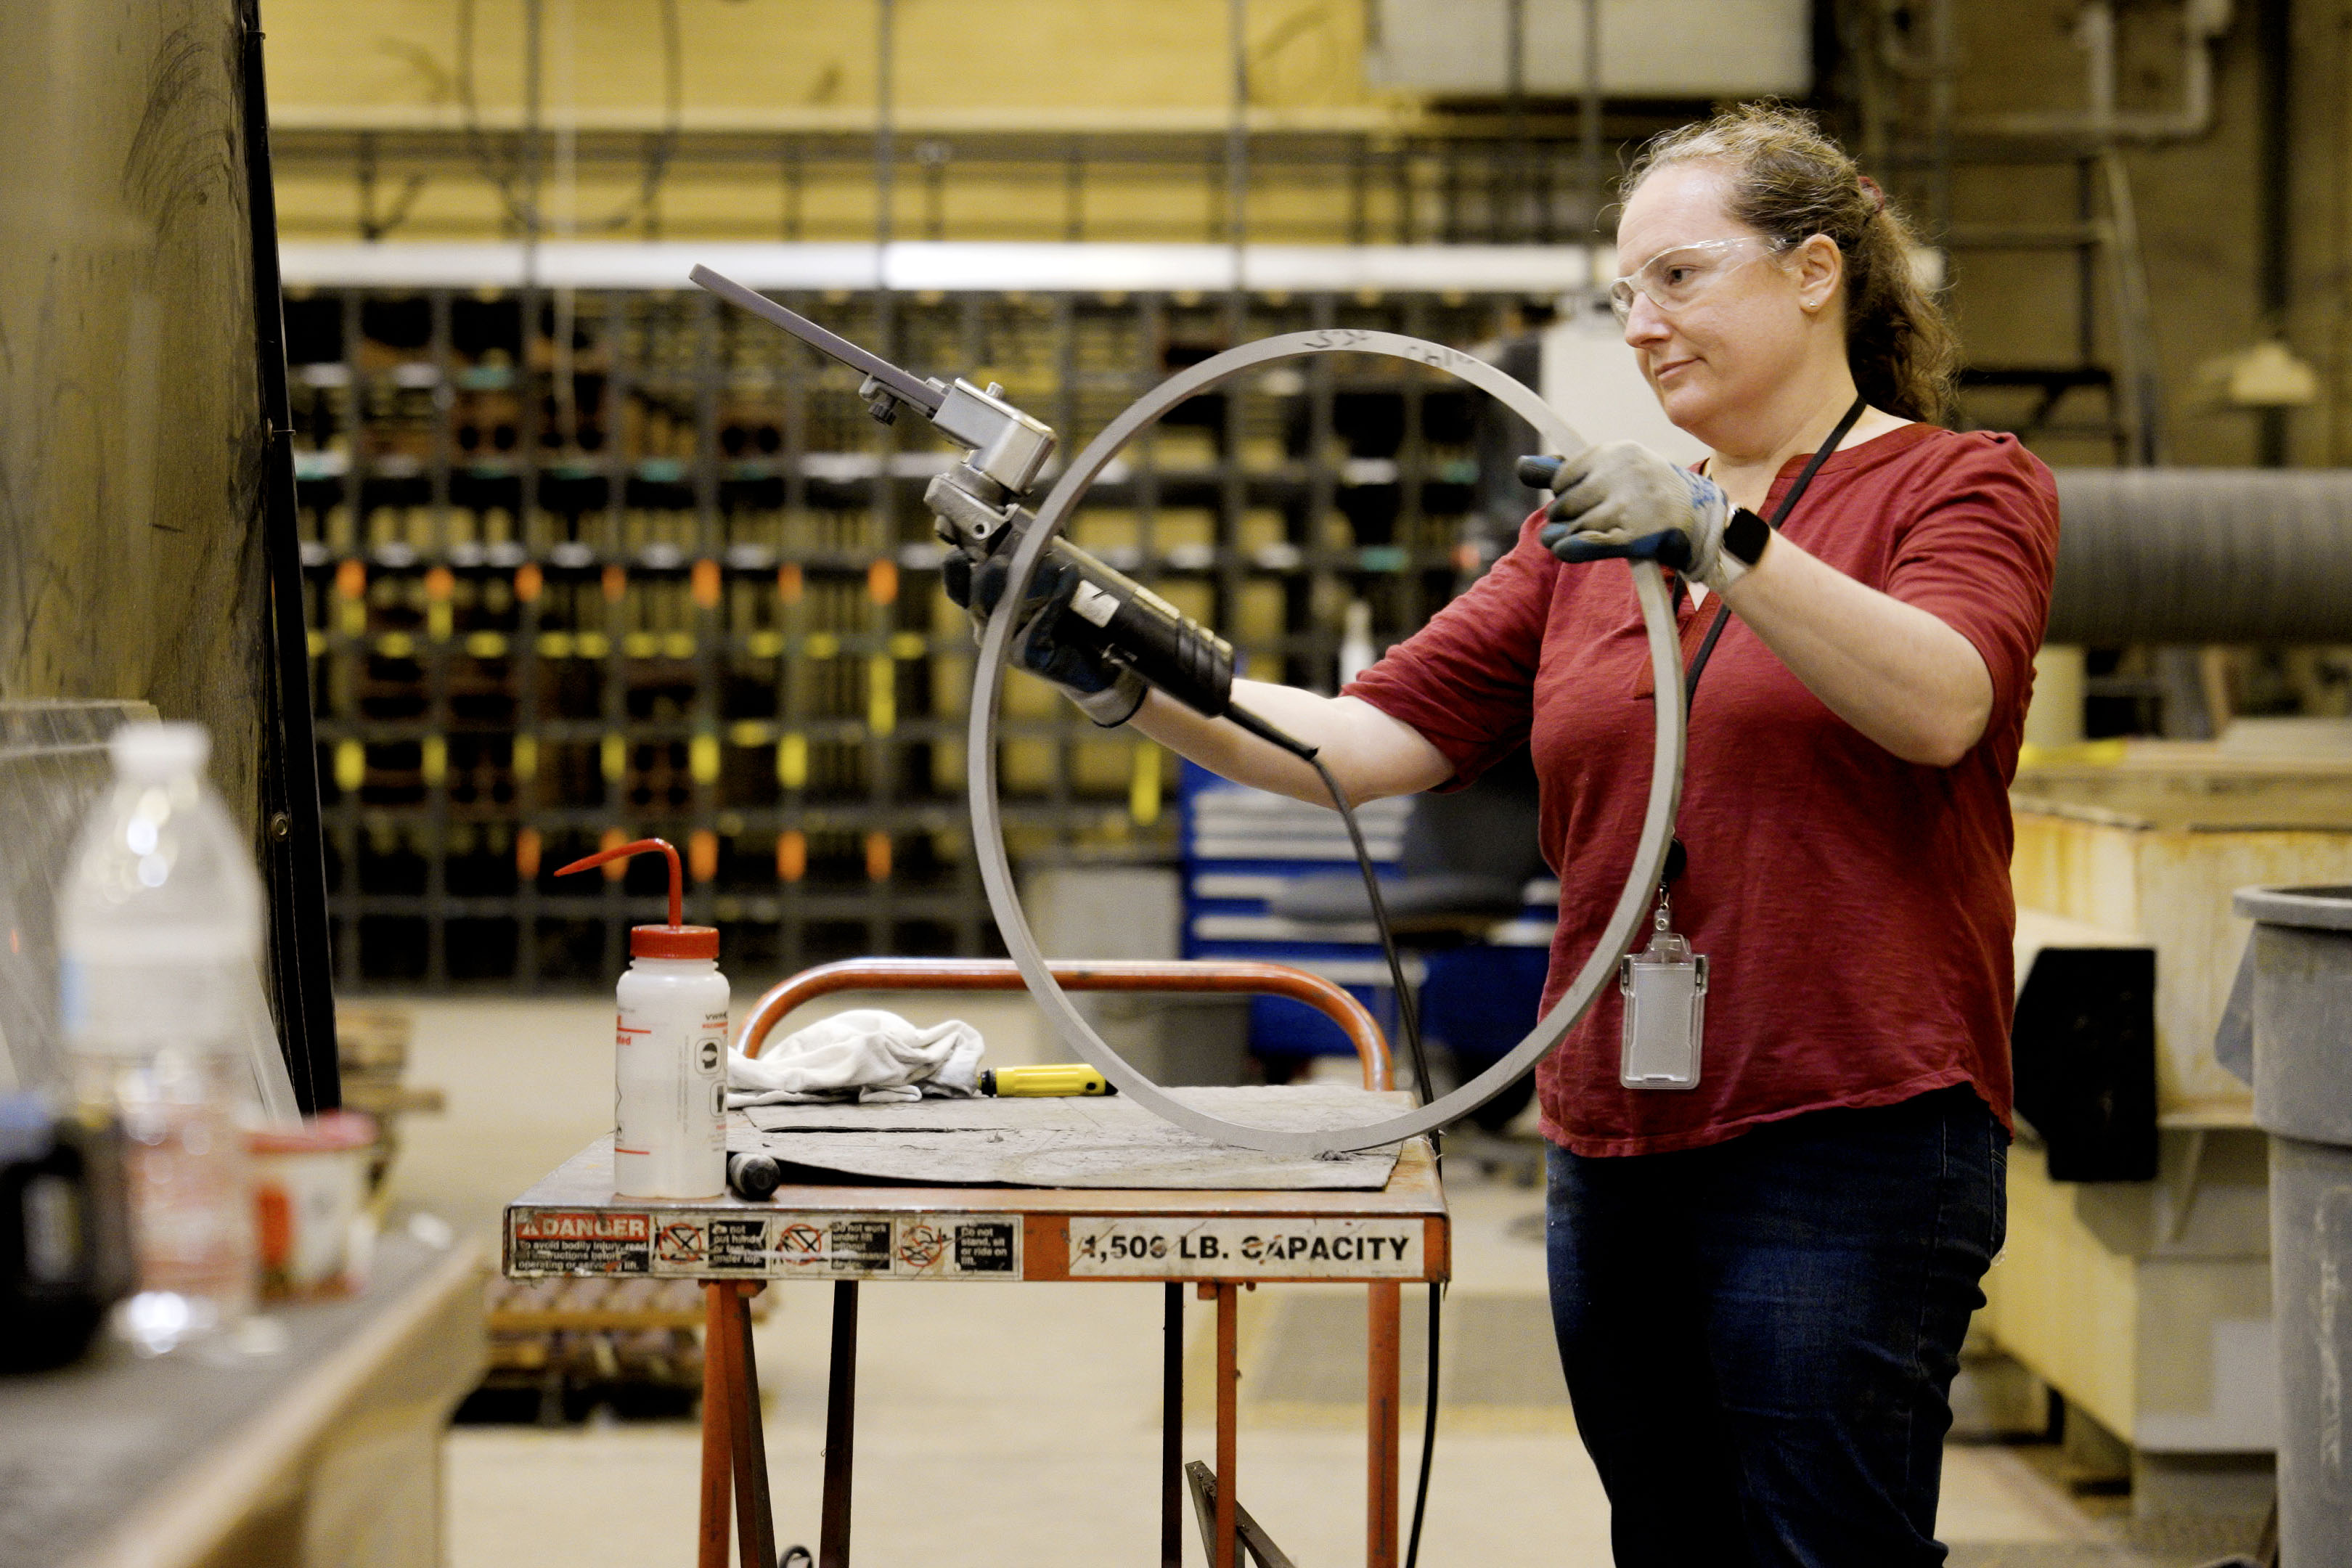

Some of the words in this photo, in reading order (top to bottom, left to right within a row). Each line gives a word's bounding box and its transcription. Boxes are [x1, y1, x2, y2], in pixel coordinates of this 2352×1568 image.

[544, 1219, 645, 1237] DANGER
[730, 1225, 746, 1234] not
[961, 1227, 975, 1237] Do
[976, 1228, 994, 1237] not
[533, 1241, 560, 1249] avoid
[562, 1241, 591, 1251] bodily
[1180, 1236, 1229, 1259] LB.
[1241, 1236, 1410, 1260] CAPACITY
[973, 1247, 992, 1257] ride
[994, 1248, 1008, 1257] on
[518, 1260, 564, 1271] operating
